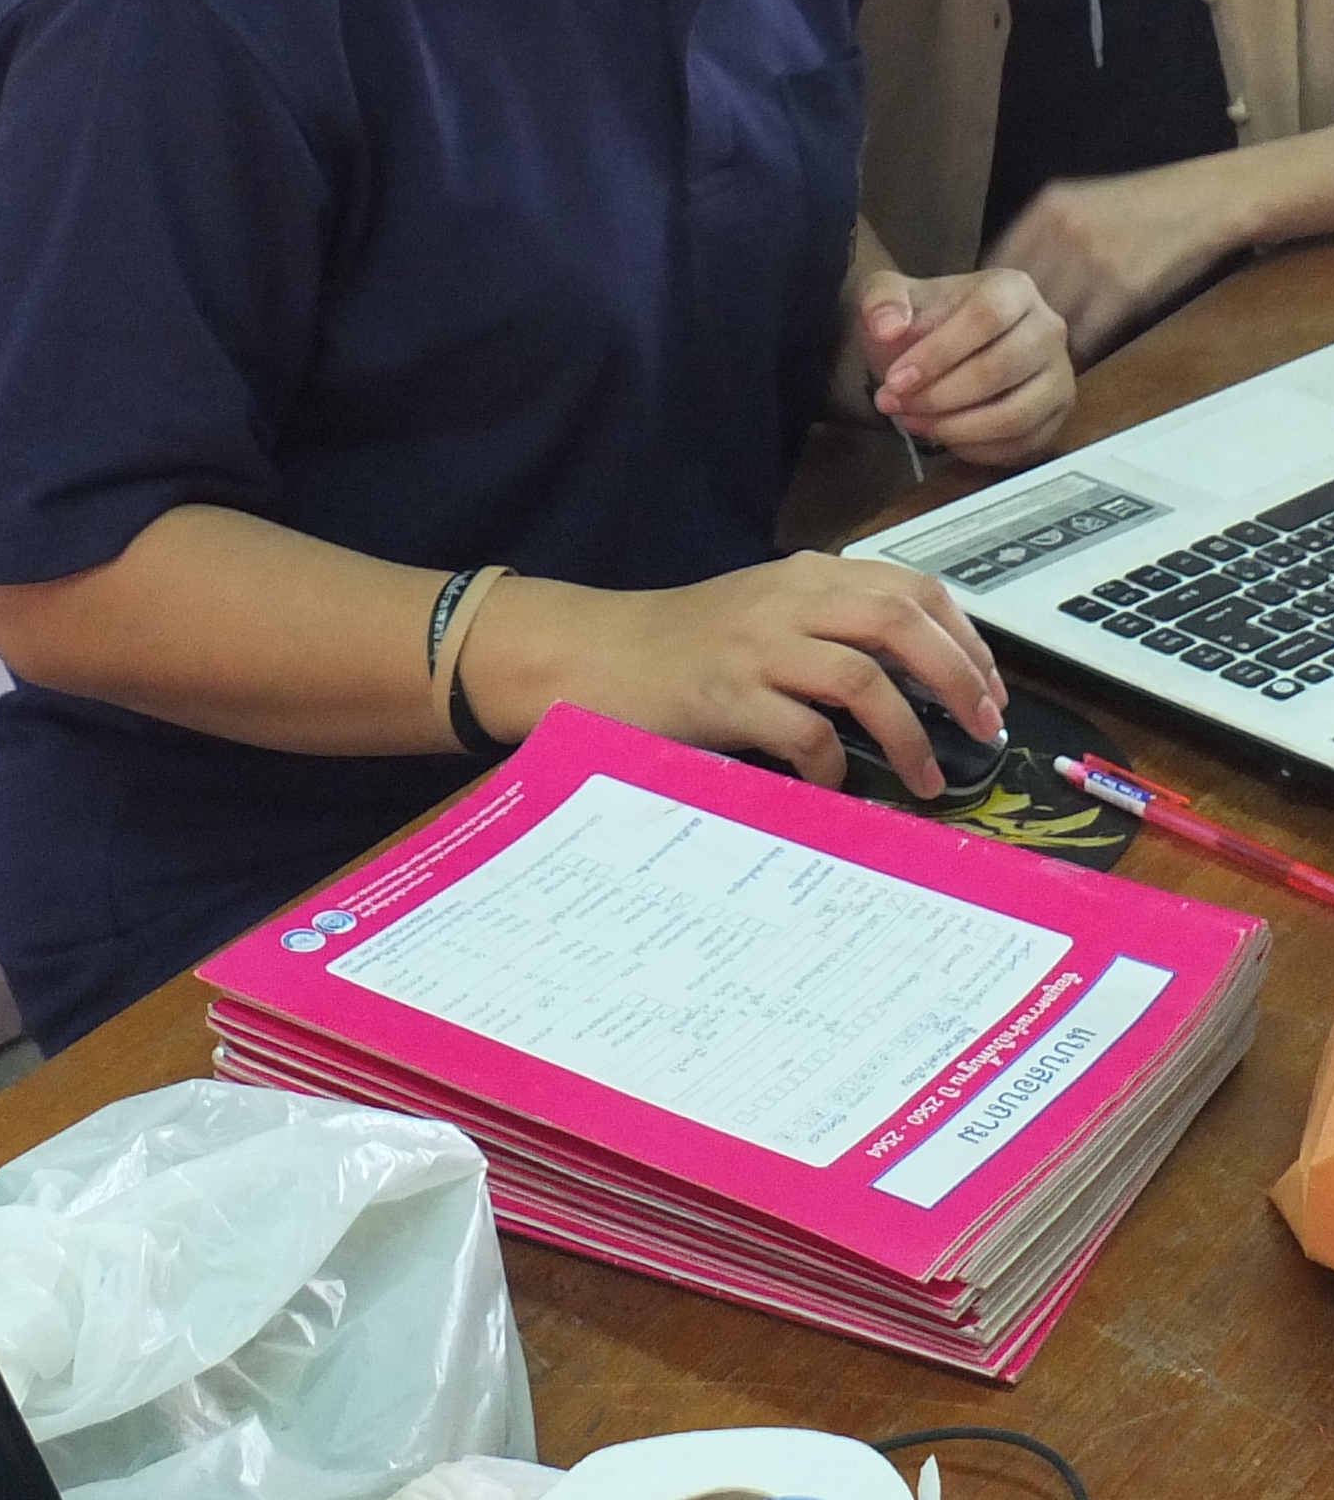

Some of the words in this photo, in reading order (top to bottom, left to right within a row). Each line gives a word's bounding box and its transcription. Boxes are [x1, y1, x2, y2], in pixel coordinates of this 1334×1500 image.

[949, 972, 1083, 1086] ข้อมูลความจำเป็นพื้นฐาน
[906, 1094, 946, 1125] 2560
[957, 1027, 1097, 1145] แบบสอบถาม
[864, 1129, 906, 1160] 2564
